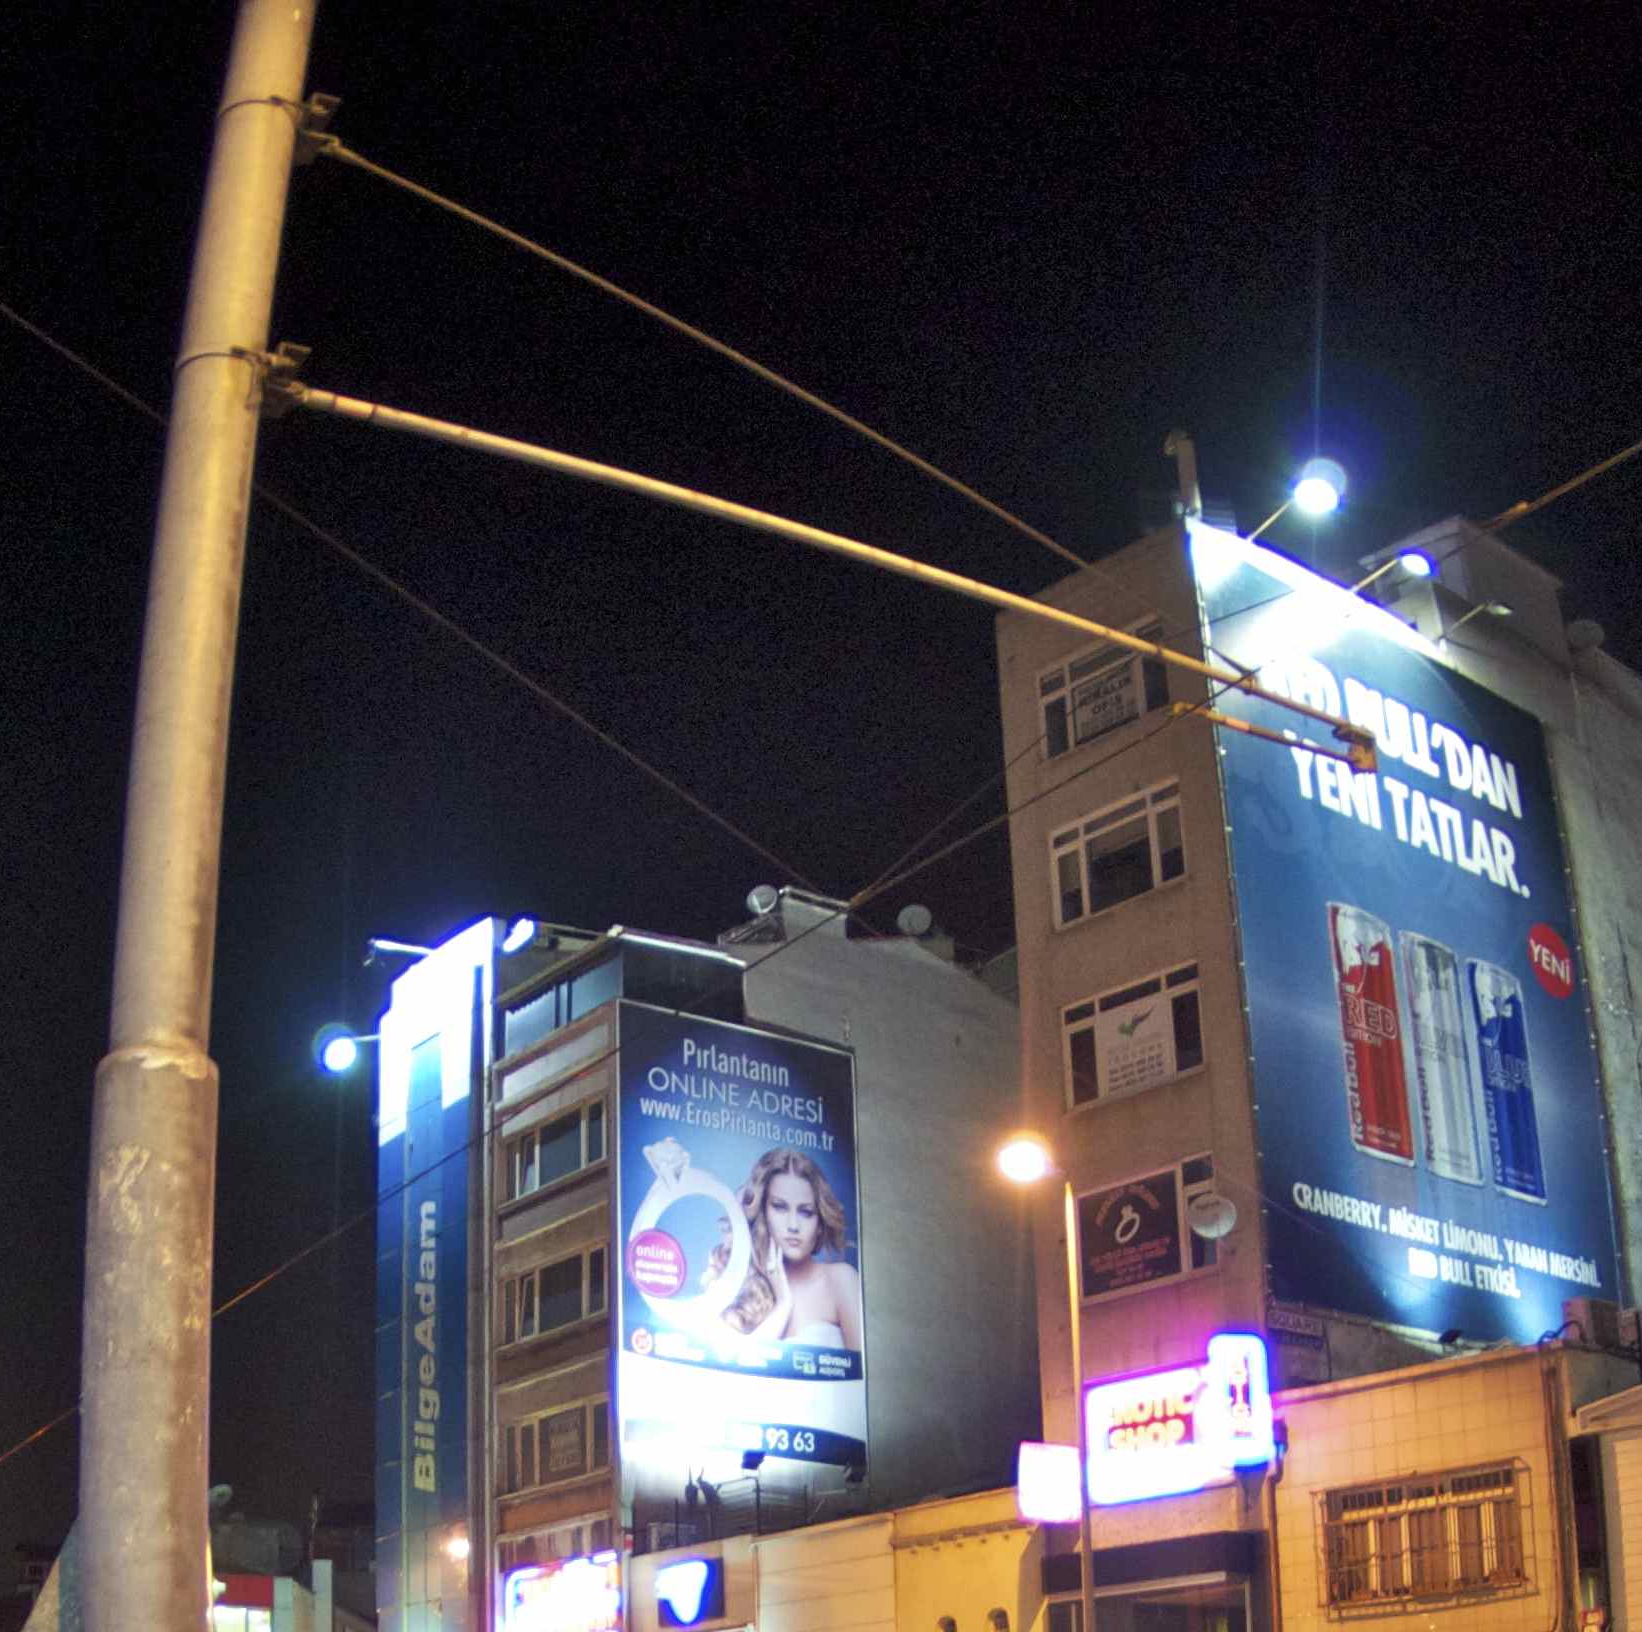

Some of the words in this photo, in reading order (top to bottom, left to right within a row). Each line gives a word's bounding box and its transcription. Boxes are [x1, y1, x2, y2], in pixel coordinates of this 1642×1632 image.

[1384, 776, 1531, 898] TATLAR.
[1529, 938, 1572, 985] YENİ
[682, 1037, 790, 1089] Pırlantanın
[647, 1066, 741, 1107] ONLINE
[746, 1089, 824, 1125] ADRESİ
[413, 1200, 441, 1493] BilgeAdam
[765, 1427, 790, 1451] 93
[793, 1431, 815, 1453] 63
